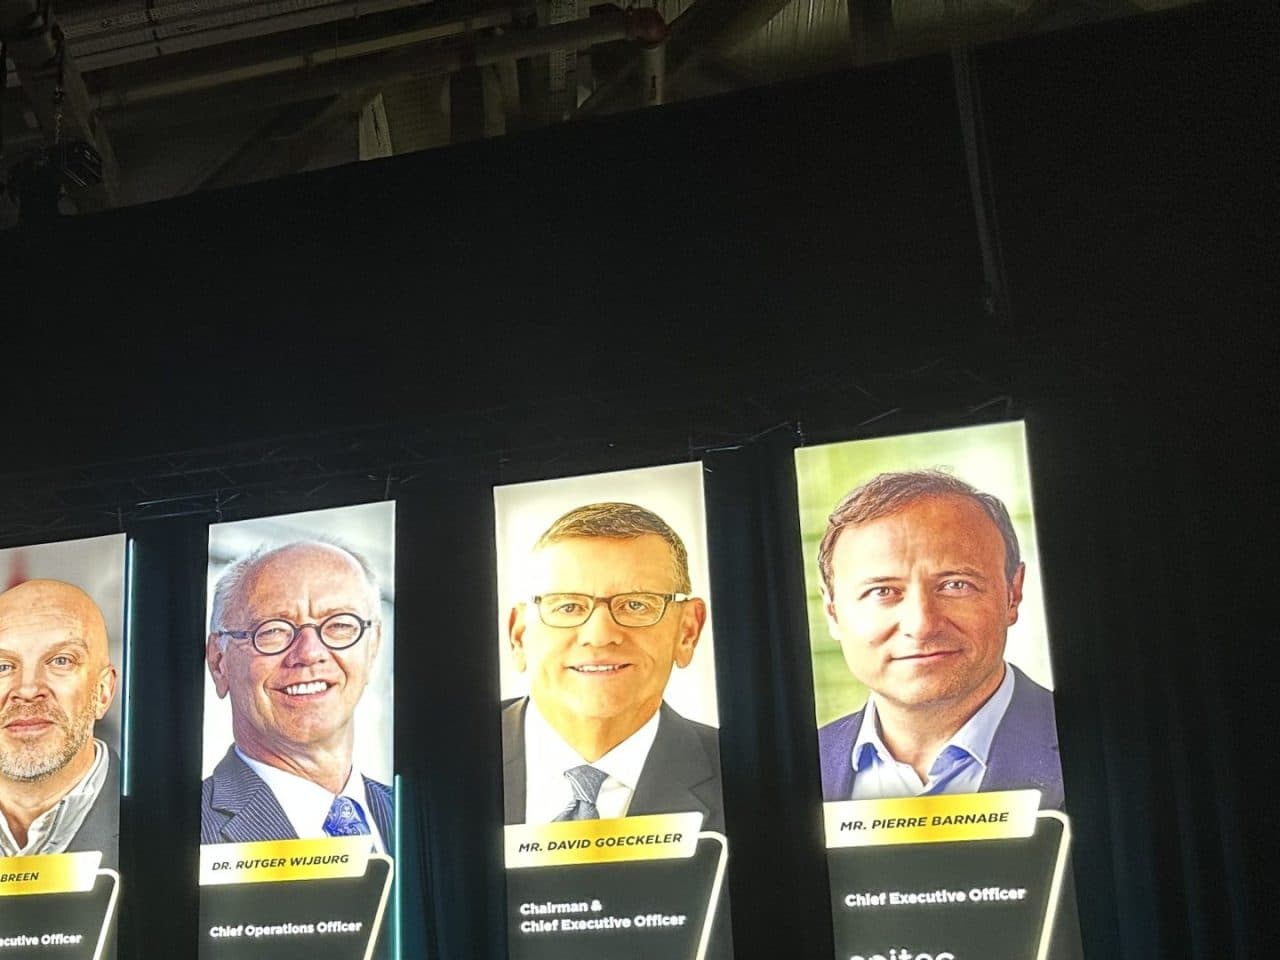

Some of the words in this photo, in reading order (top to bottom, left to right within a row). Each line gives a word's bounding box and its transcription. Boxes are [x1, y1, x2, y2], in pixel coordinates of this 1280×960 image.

[840, 820, 867, 831] MR.
[872, 816, 927, 829] PIERRE
[931, 812, 1009, 826] BARNABE
[518, 842, 543, 853] MR.
[547, 839, 591, 851] DAVID
[595, 833, 683, 848] GOECKELER
[212, 861, 232, 871] DR.
[236, 858, 286, 869] RUTGER
[290, 854, 349, 867] WIJBURG
[0, 872, 39, 883] BREEN
[844, 892, 886, 907] Chief
[889, 889, 967, 905] Executive
[969, 887, 1027, 902] Officer
[520, 901, 588, 915] Chairman
[590, 899, 603, 912] &
[209, 925, 243, 938] Chief
[244, 923, 315, 938] Operations
[316, 921, 363, 934] Officer
[520, 918, 558, 932] Chief
[561, 916, 631, 931] Executive
[634, 914, 687, 928] Officer
[41, 933, 83, 946] Officer
